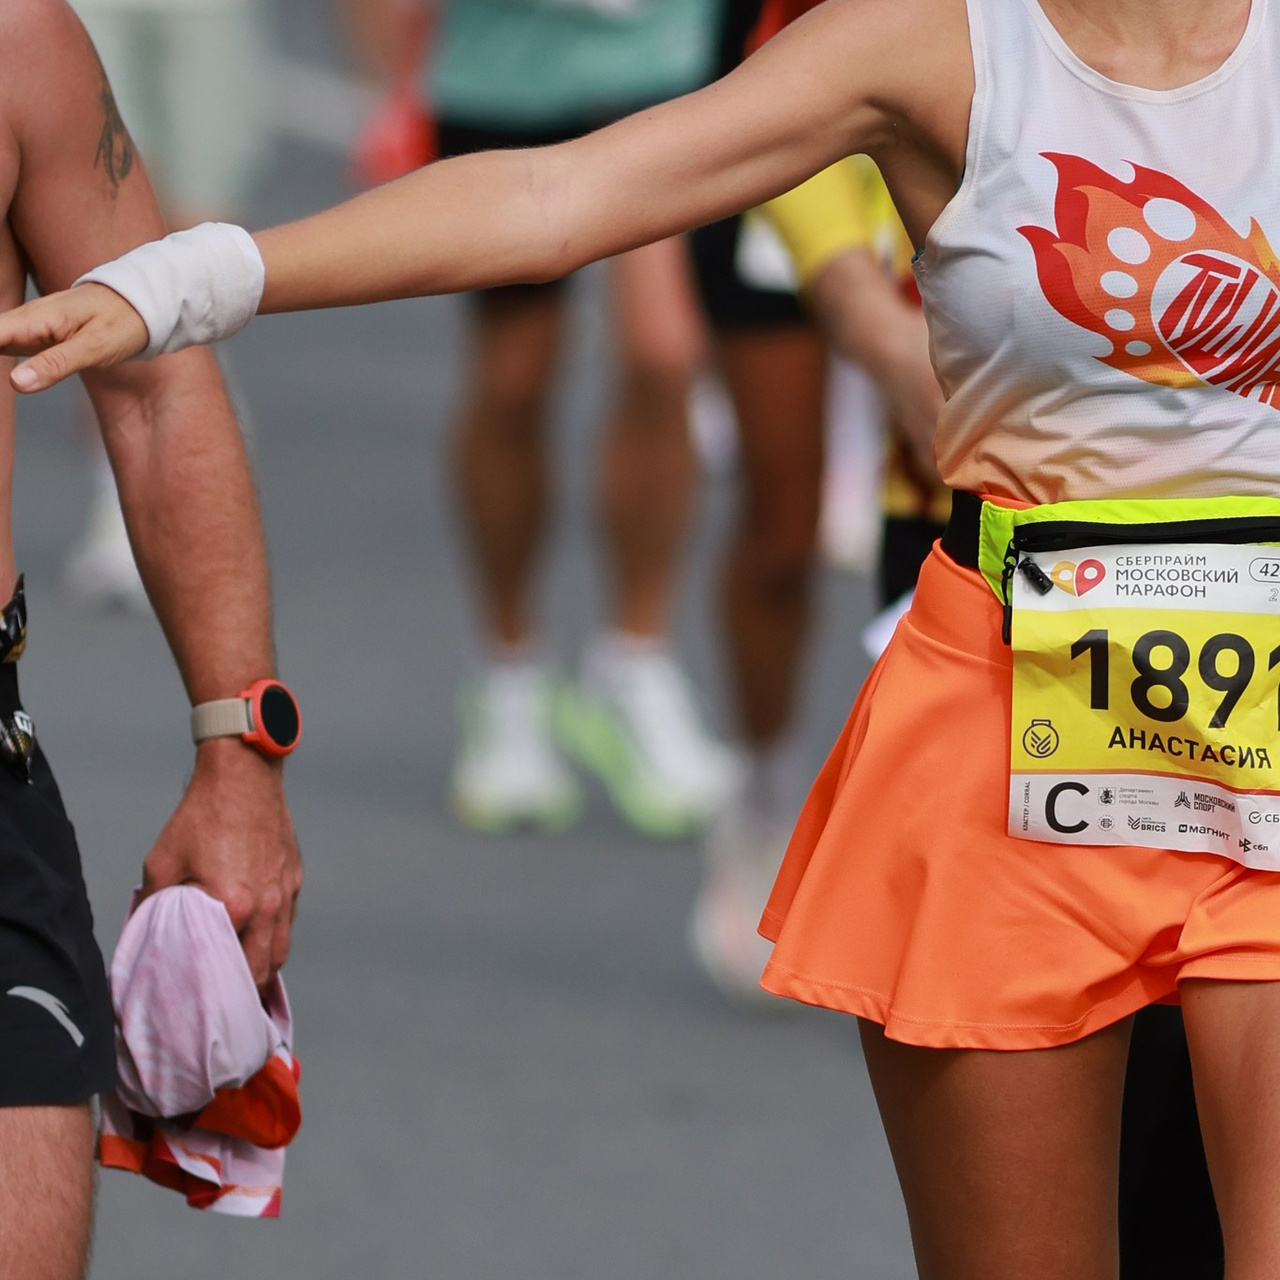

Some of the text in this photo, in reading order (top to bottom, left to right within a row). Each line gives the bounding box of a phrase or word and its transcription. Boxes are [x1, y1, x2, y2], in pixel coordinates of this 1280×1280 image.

[1116, 554, 1206, 567] СБЕРПРАЙМ
[1116, 568, 1238, 583] МОСКОВСКИЙ
[1116, 584, 1206, 598] МАРАФОН
[1108, 726, 1272, 769] АНАСТАСИЯ
[1193, 803, 1215, 813] СПОРТ
[1194, 793, 1236, 813] МОСКОВСКИЙ
[1141, 824, 1166, 832] BRICS
[1189, 825, 1230, 841] магнит
